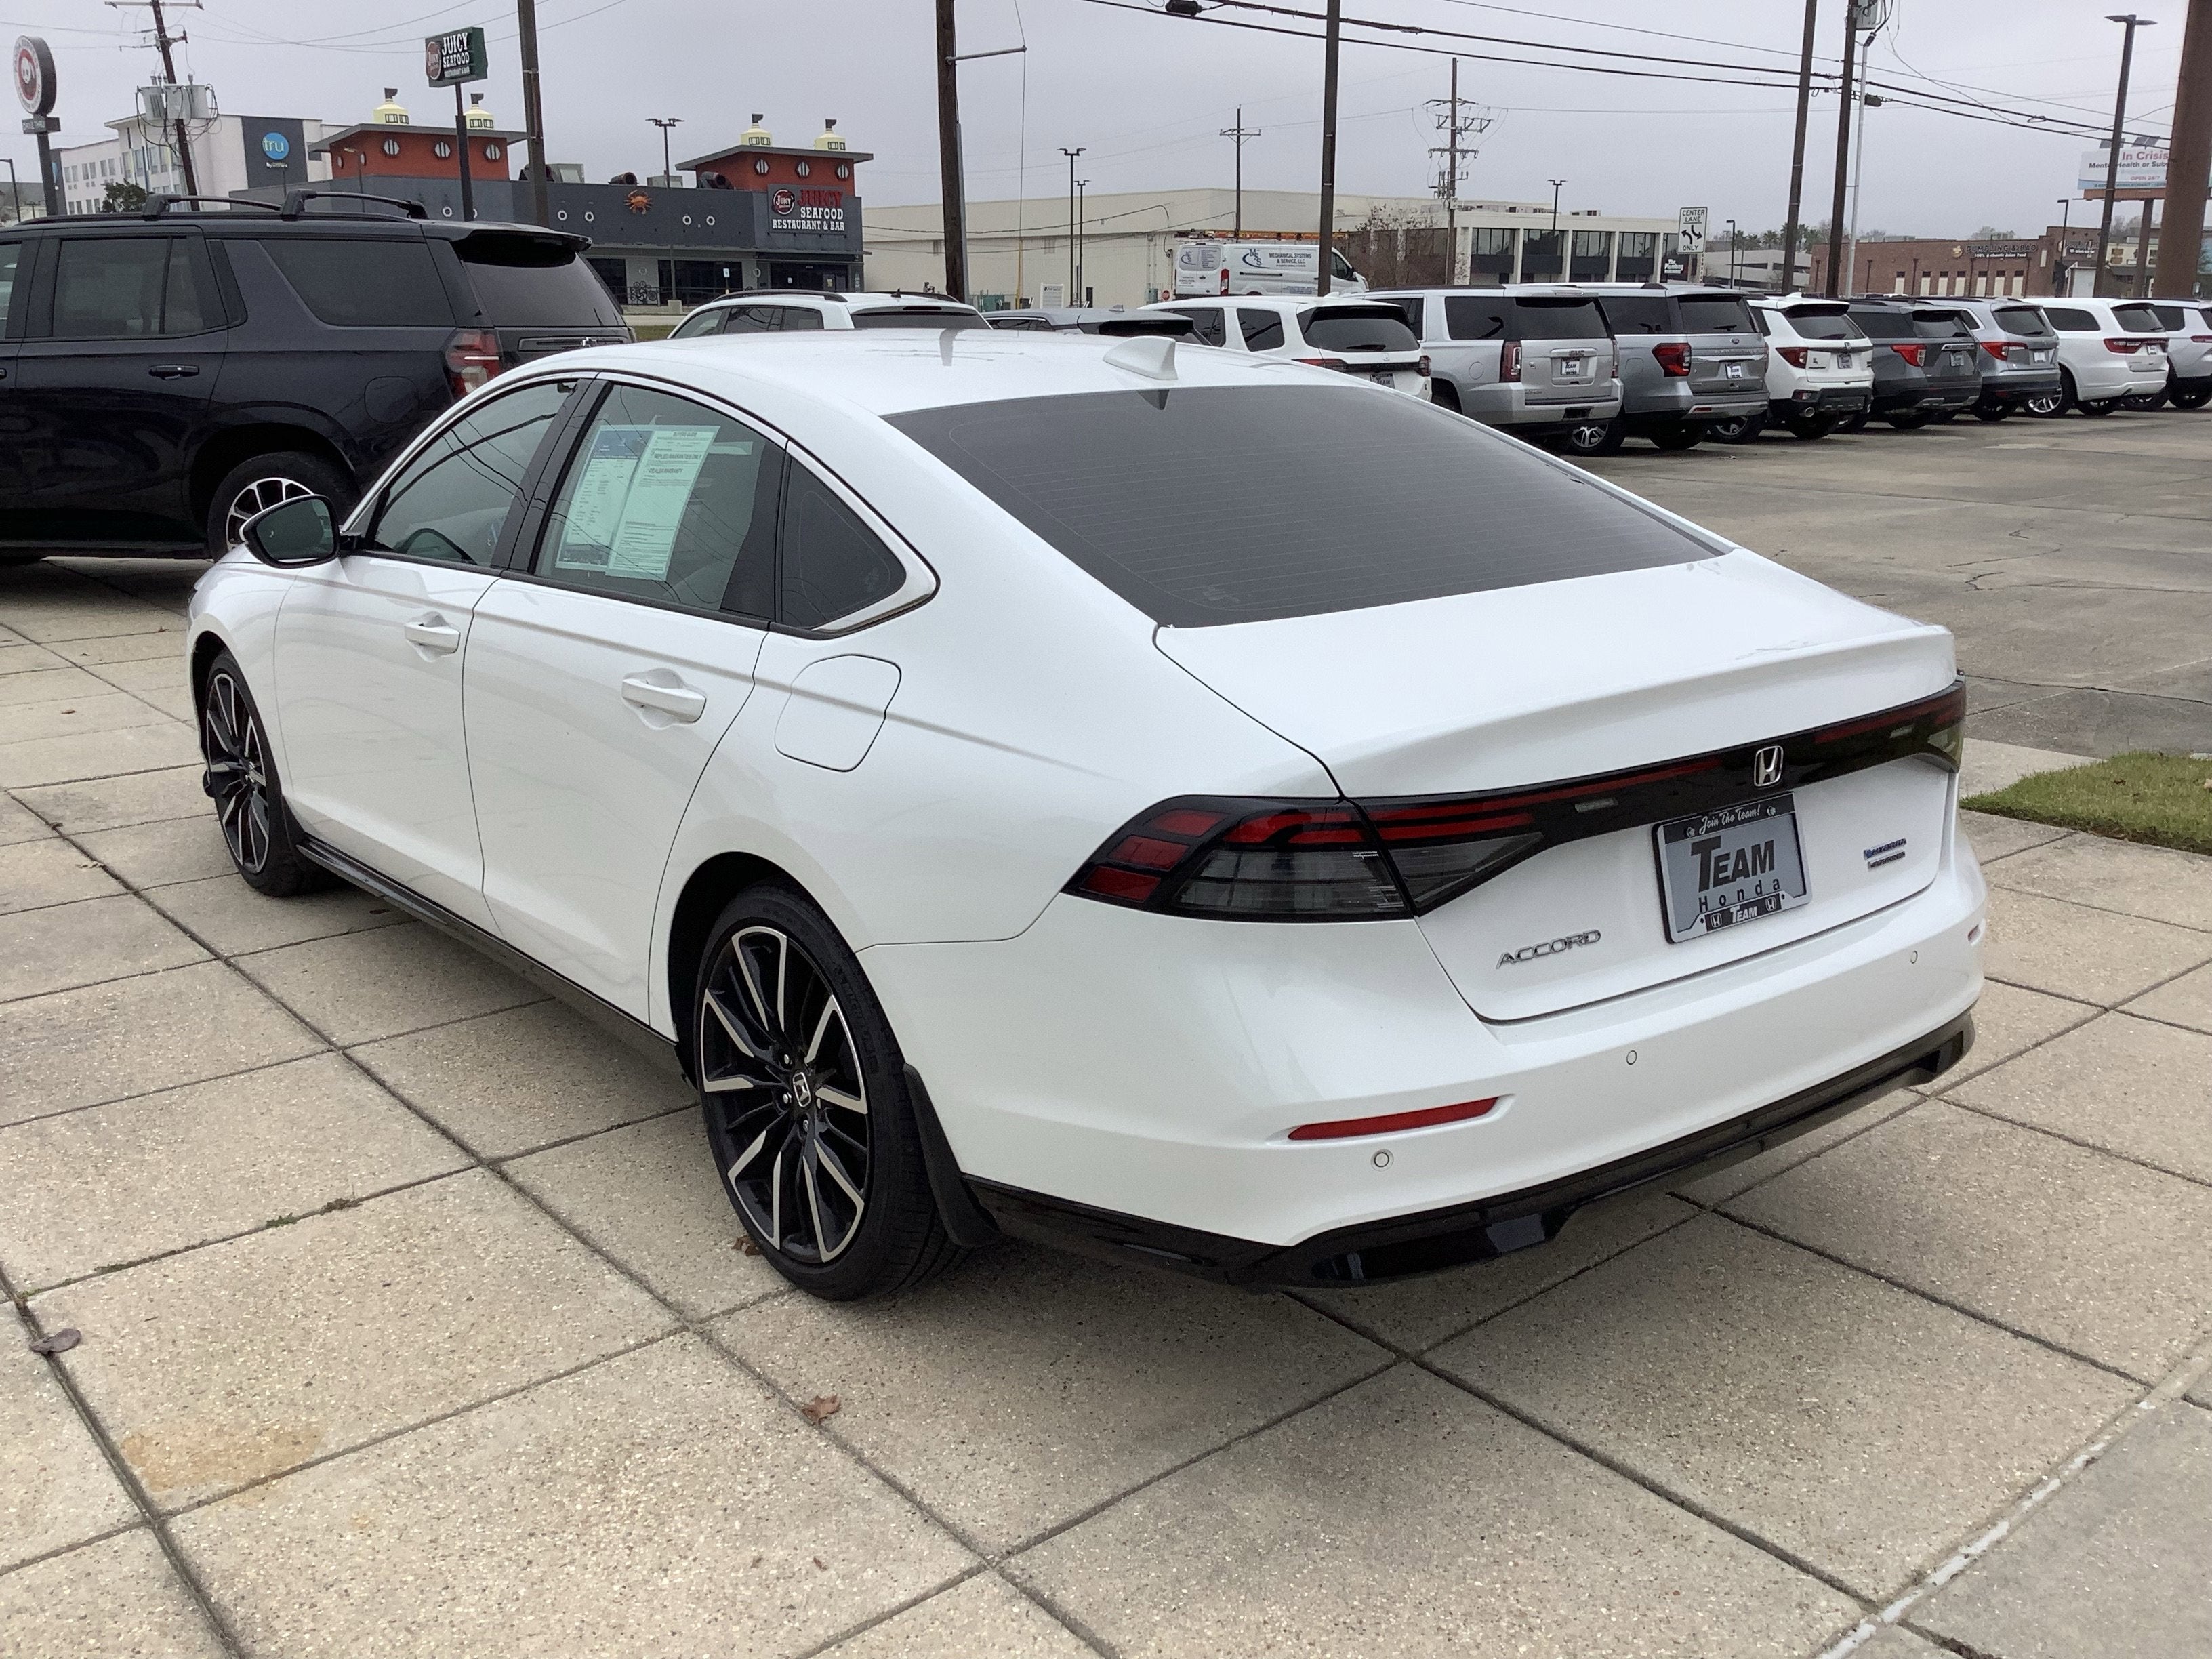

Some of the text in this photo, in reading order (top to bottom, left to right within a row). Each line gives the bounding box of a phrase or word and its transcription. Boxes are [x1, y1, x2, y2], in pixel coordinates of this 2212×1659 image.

[442, 32, 468, 56] JUICY
[443, 52, 470, 68] SEAFOOD
[262, 138, 284, 152] tru
[2122, 150, 2168, 161] In Crisis
[798, 189, 842, 207] JUICY
[800, 207, 844, 220] SEAFOOD
[773, 219, 844, 231] RESTAURANT & BAR
[1699, 804, 1761, 835] Join The Team!
[1691, 835, 1775, 893] TEAM
[1699, 878, 1780, 913] Honda
[1730, 905, 1757, 924] TEAM
[1496, 930, 1601, 970] ACCORD
